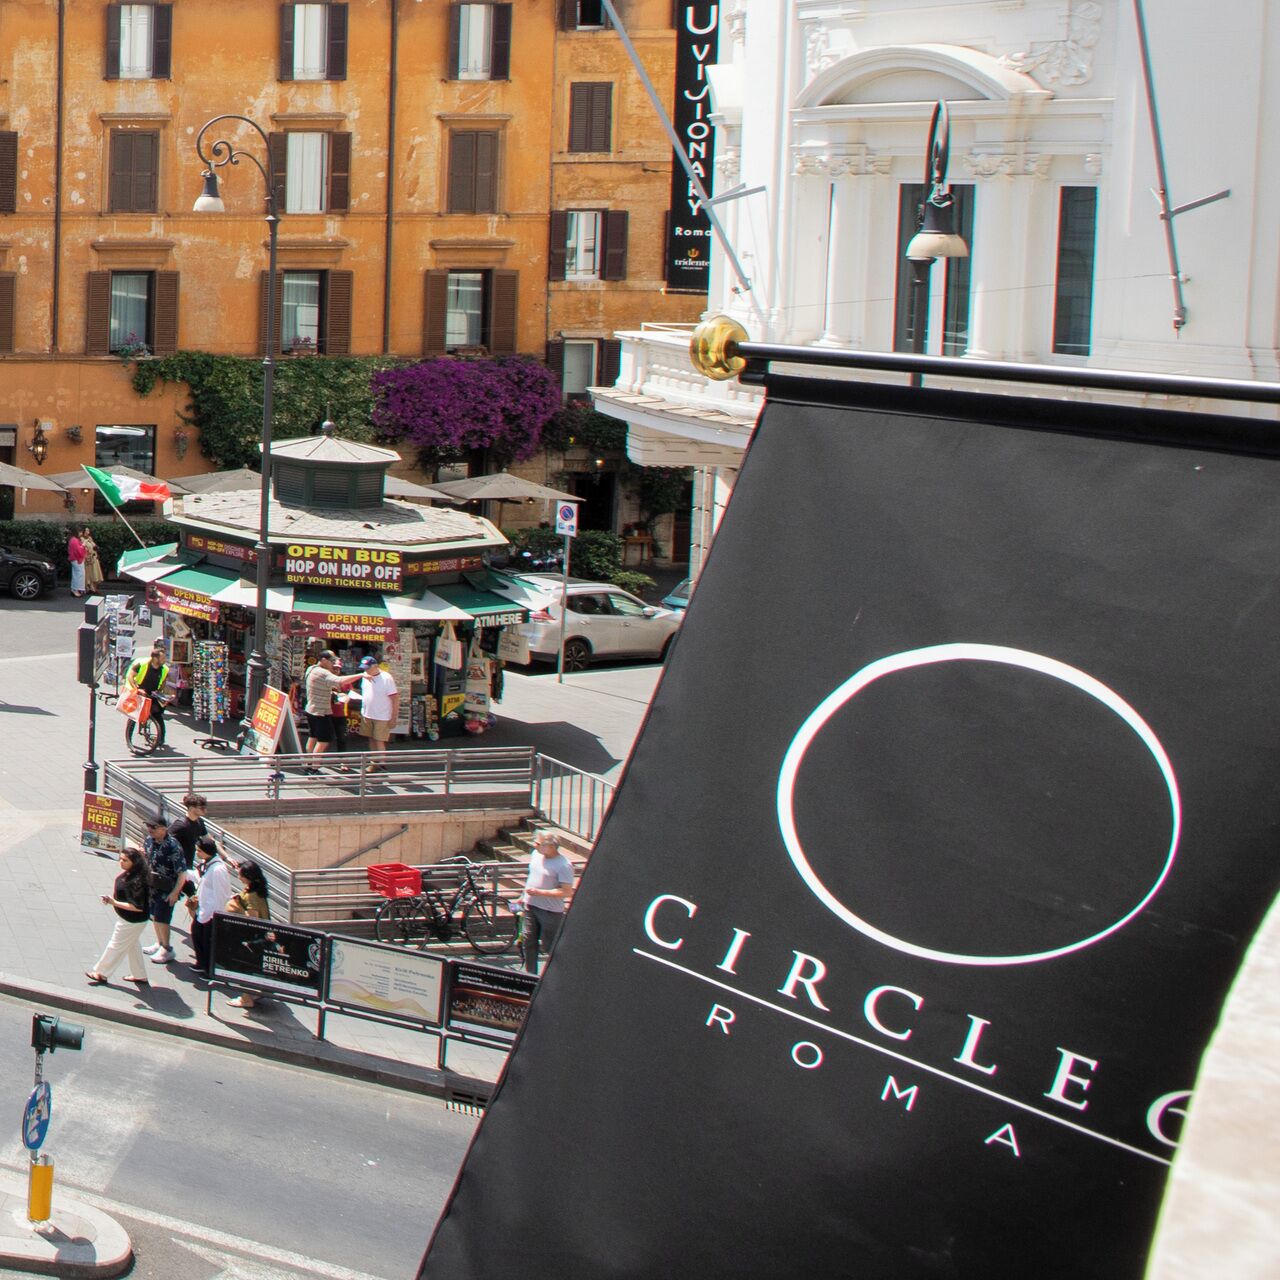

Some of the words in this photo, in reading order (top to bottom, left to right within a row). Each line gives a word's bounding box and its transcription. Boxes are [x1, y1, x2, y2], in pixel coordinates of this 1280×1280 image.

[675, 258, 710, 267] tridente
[287, 545, 348, 560] OPEN
[356, 549, 401, 564] BUS
[286, 559, 315, 573] HOP
[318, 561, 337, 576] ON
[342, 563, 371, 577] HOP
[374, 565, 401, 580] OFF
[307, 576, 332, 585] YOUR
[335, 578, 372, 588] TICKETS
[375, 581, 399, 590] HERE
[174, 588, 195, 600] OPEN
[195, 593, 212, 604] BUS
[189, 601, 216, 613] HOP-OFF
[328, 614, 358, 624] OPEN
[361, 616, 384, 625] BUS
[474, 616, 495, 629] ATM
[496, 613, 523, 625] HERE
[319, 623, 352, 631] HOP-ON
[354, 624, 392, 634] HOP-OFF
[327, 631, 361, 640] TICKETS
[363, 633, 385, 641] HERE
[256, 708, 279, 726] HERE
[87, 812, 118, 828] HERE
[262, 955, 290, 967] KIRILL
[262, 962, 309, 978] PETRENKO
[644, 894, 1099, 1111] CIRCLE
[705, 1003, 1020, 1157] ROMA
